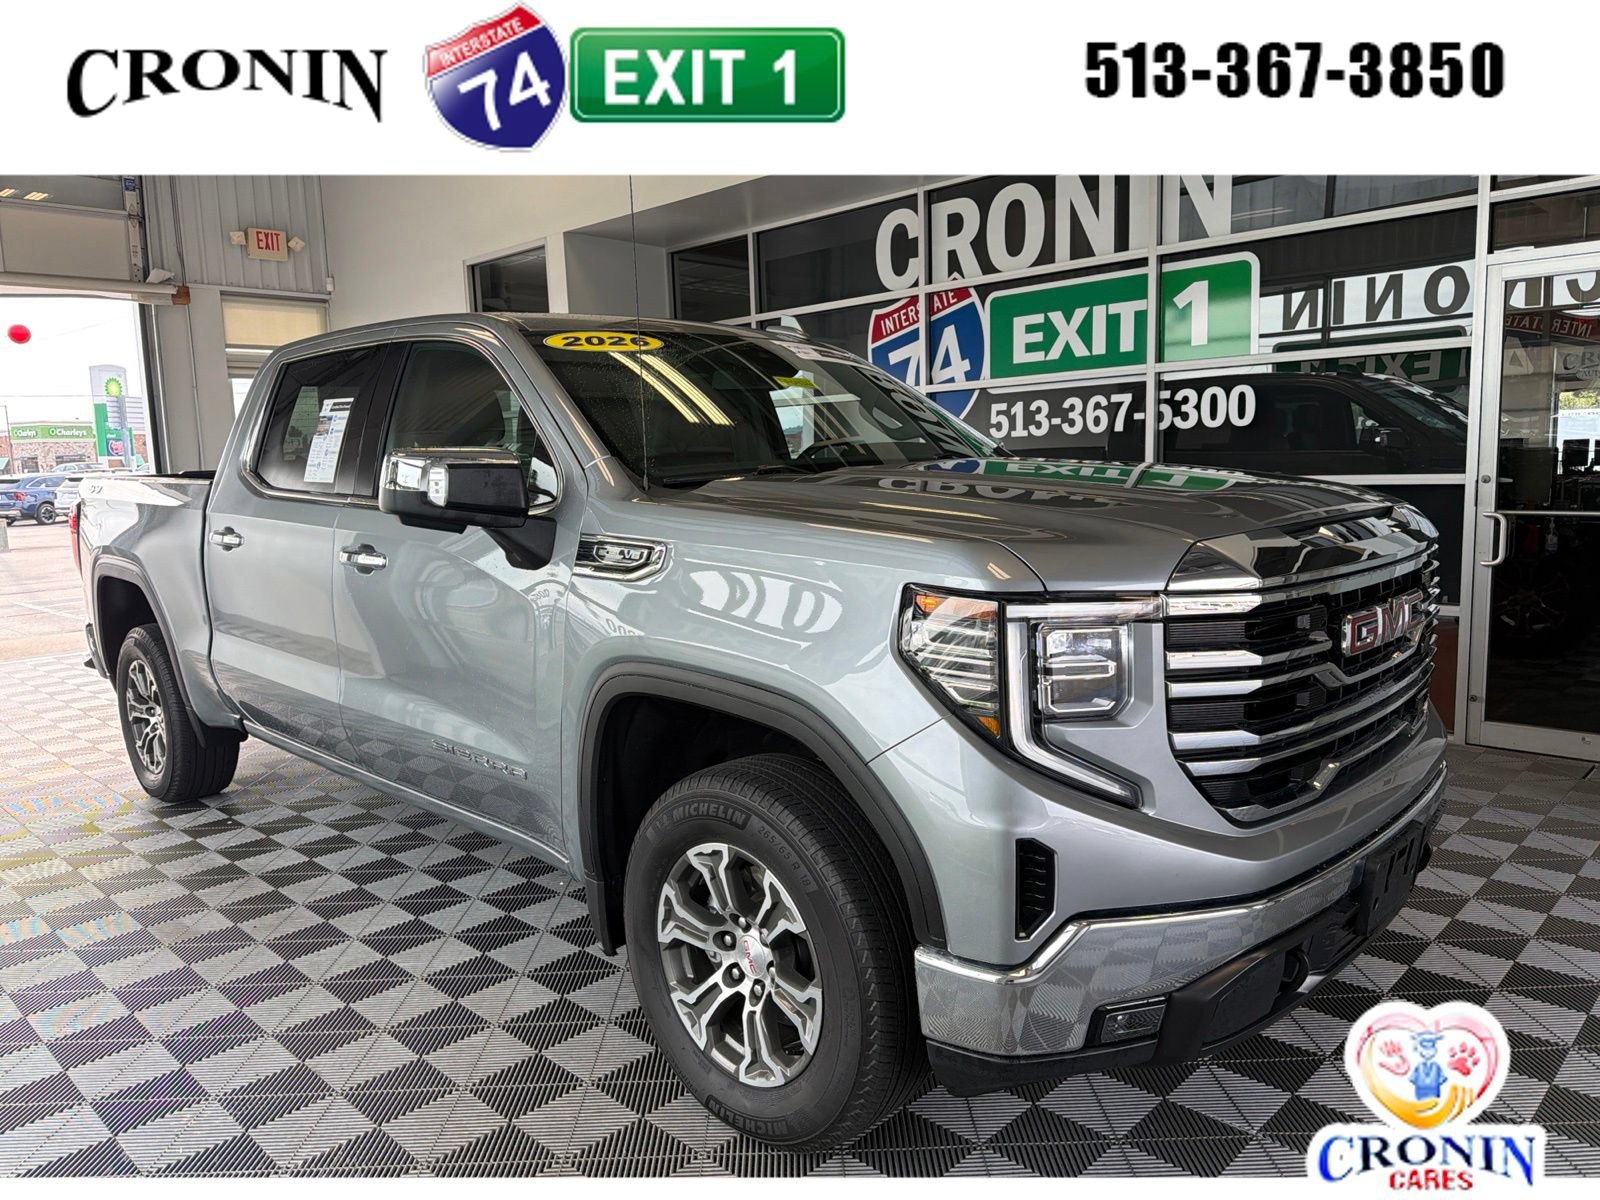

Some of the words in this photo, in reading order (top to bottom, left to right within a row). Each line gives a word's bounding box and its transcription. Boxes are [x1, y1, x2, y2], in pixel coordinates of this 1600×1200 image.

[255, 231, 281, 251] EXIT
[875, 175, 1232, 291] CRONIN
[880, 289, 958, 337] INTERATE
[1013, 299, 1148, 364] EXIT
[1173, 279, 1209, 347] 1
[561, 334, 651, 348] 2026
[989, 384, 1257, 439] 513-367-5300
[1342, 587, 1424, 658] GMC
[672, 802, 746, 826] MICHELIN
[742, 938, 758, 975] GMC
[706, 1098, 789, 1136] MICHELIN
